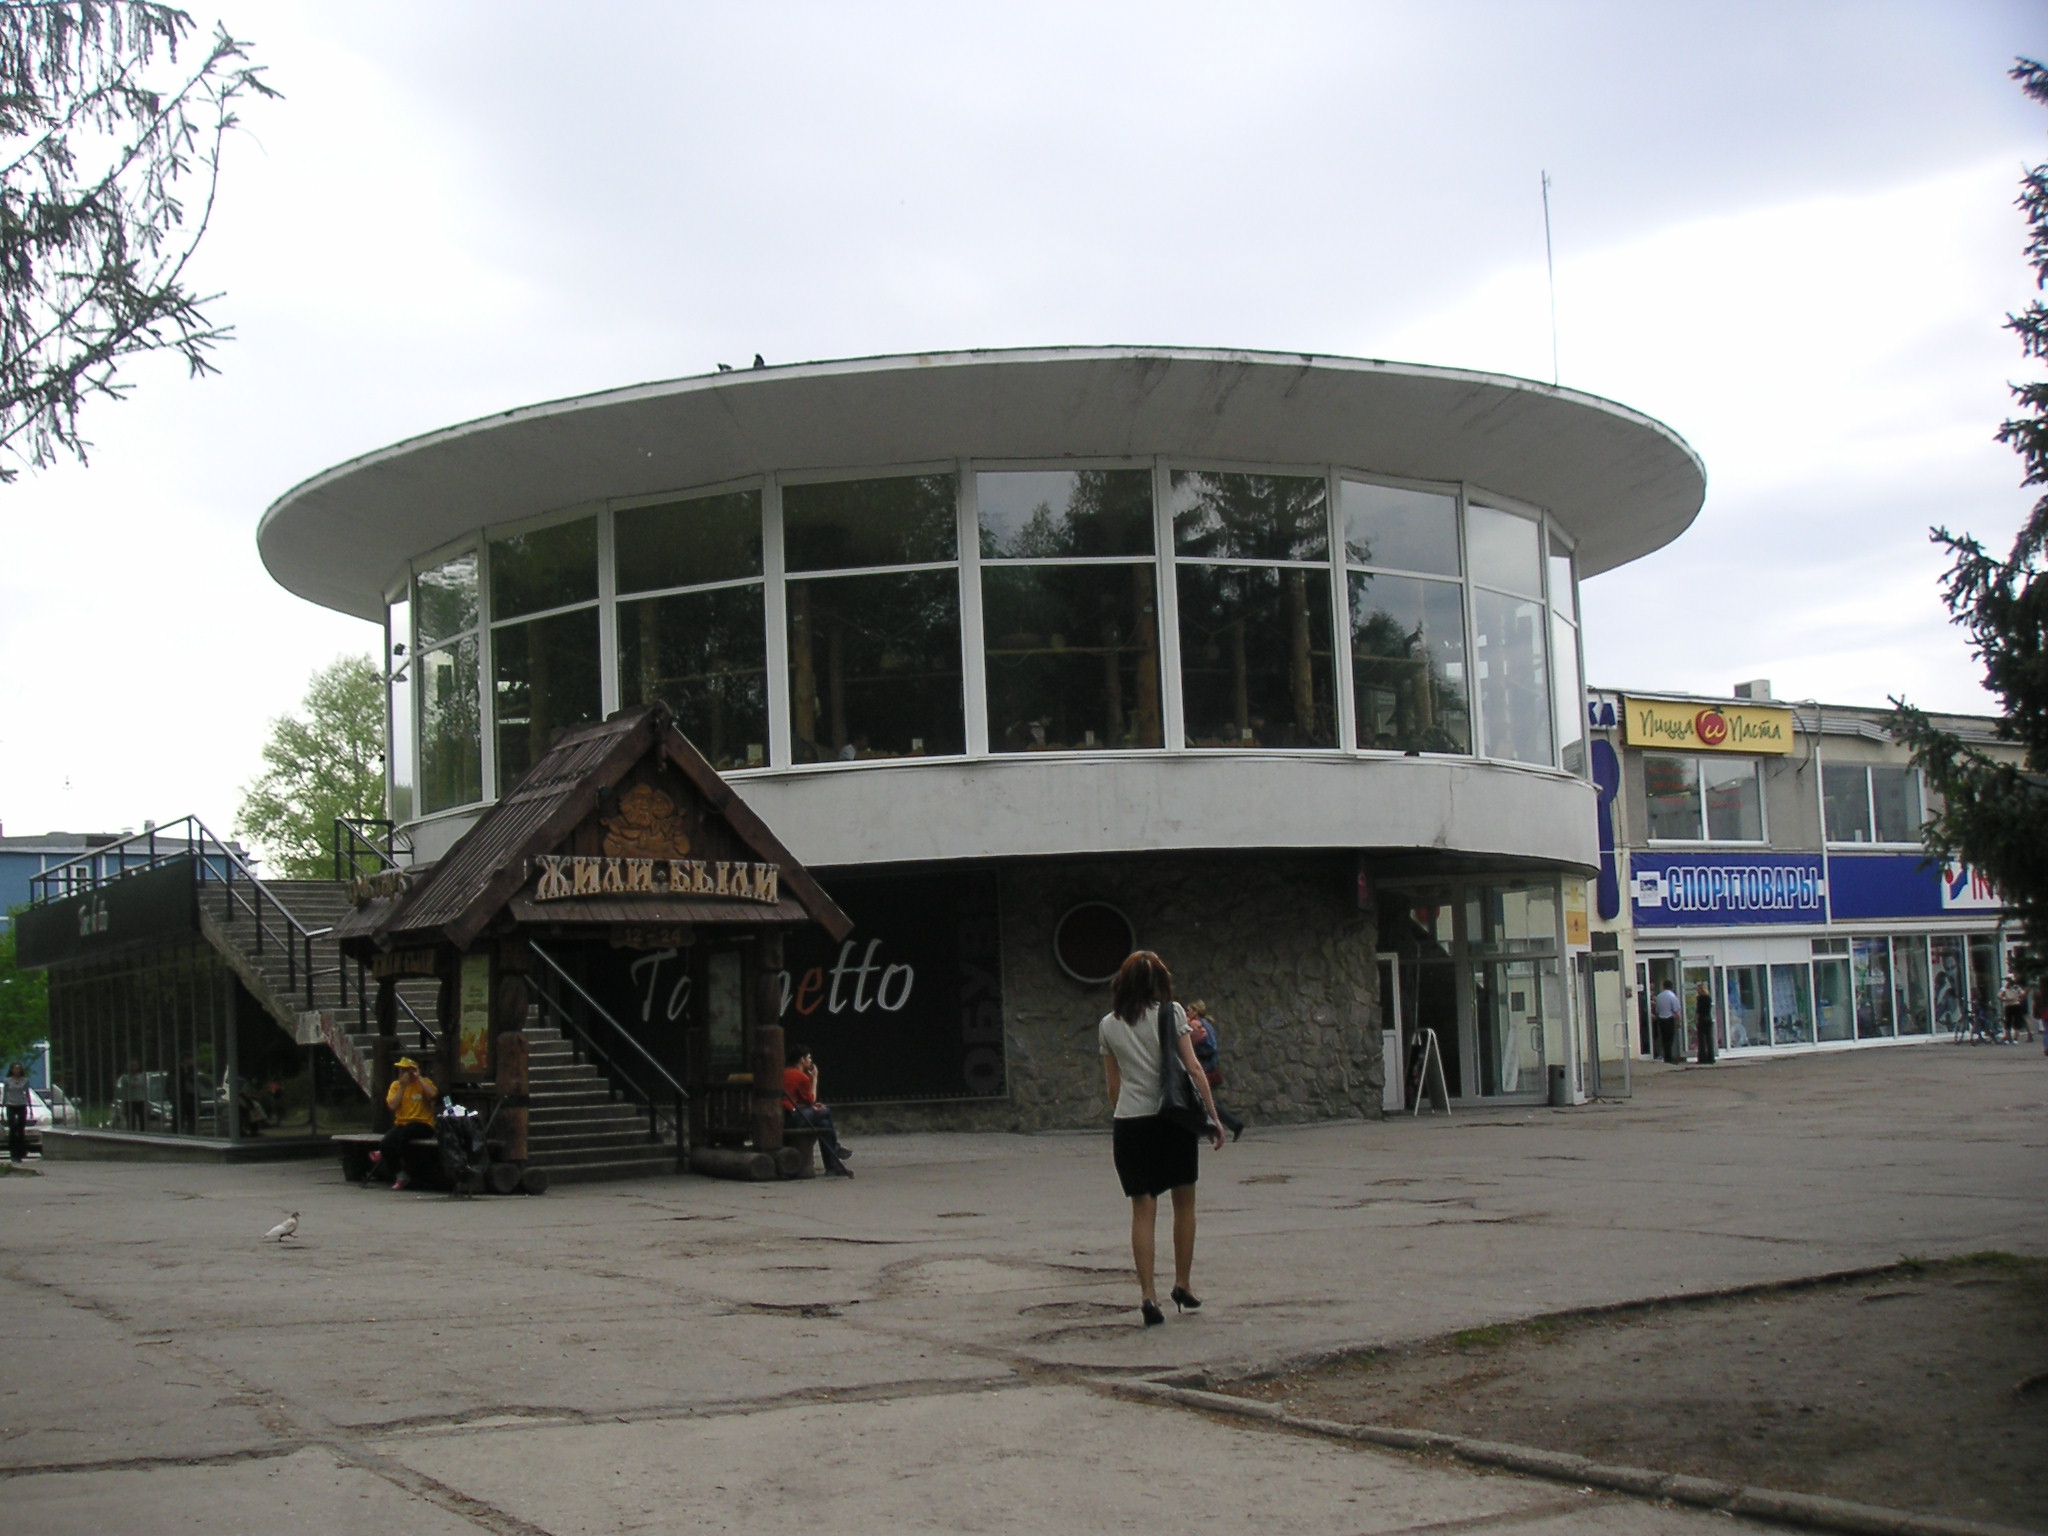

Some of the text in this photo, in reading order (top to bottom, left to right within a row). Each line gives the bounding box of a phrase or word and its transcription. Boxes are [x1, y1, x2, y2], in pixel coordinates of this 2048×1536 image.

[1729, 715, 1782, 743] Паста
[535, 855, 780, 904] ЖИЛИ БЫЛИ
[1666, 866, 1819, 912] СПОРТТОВАРЫ
